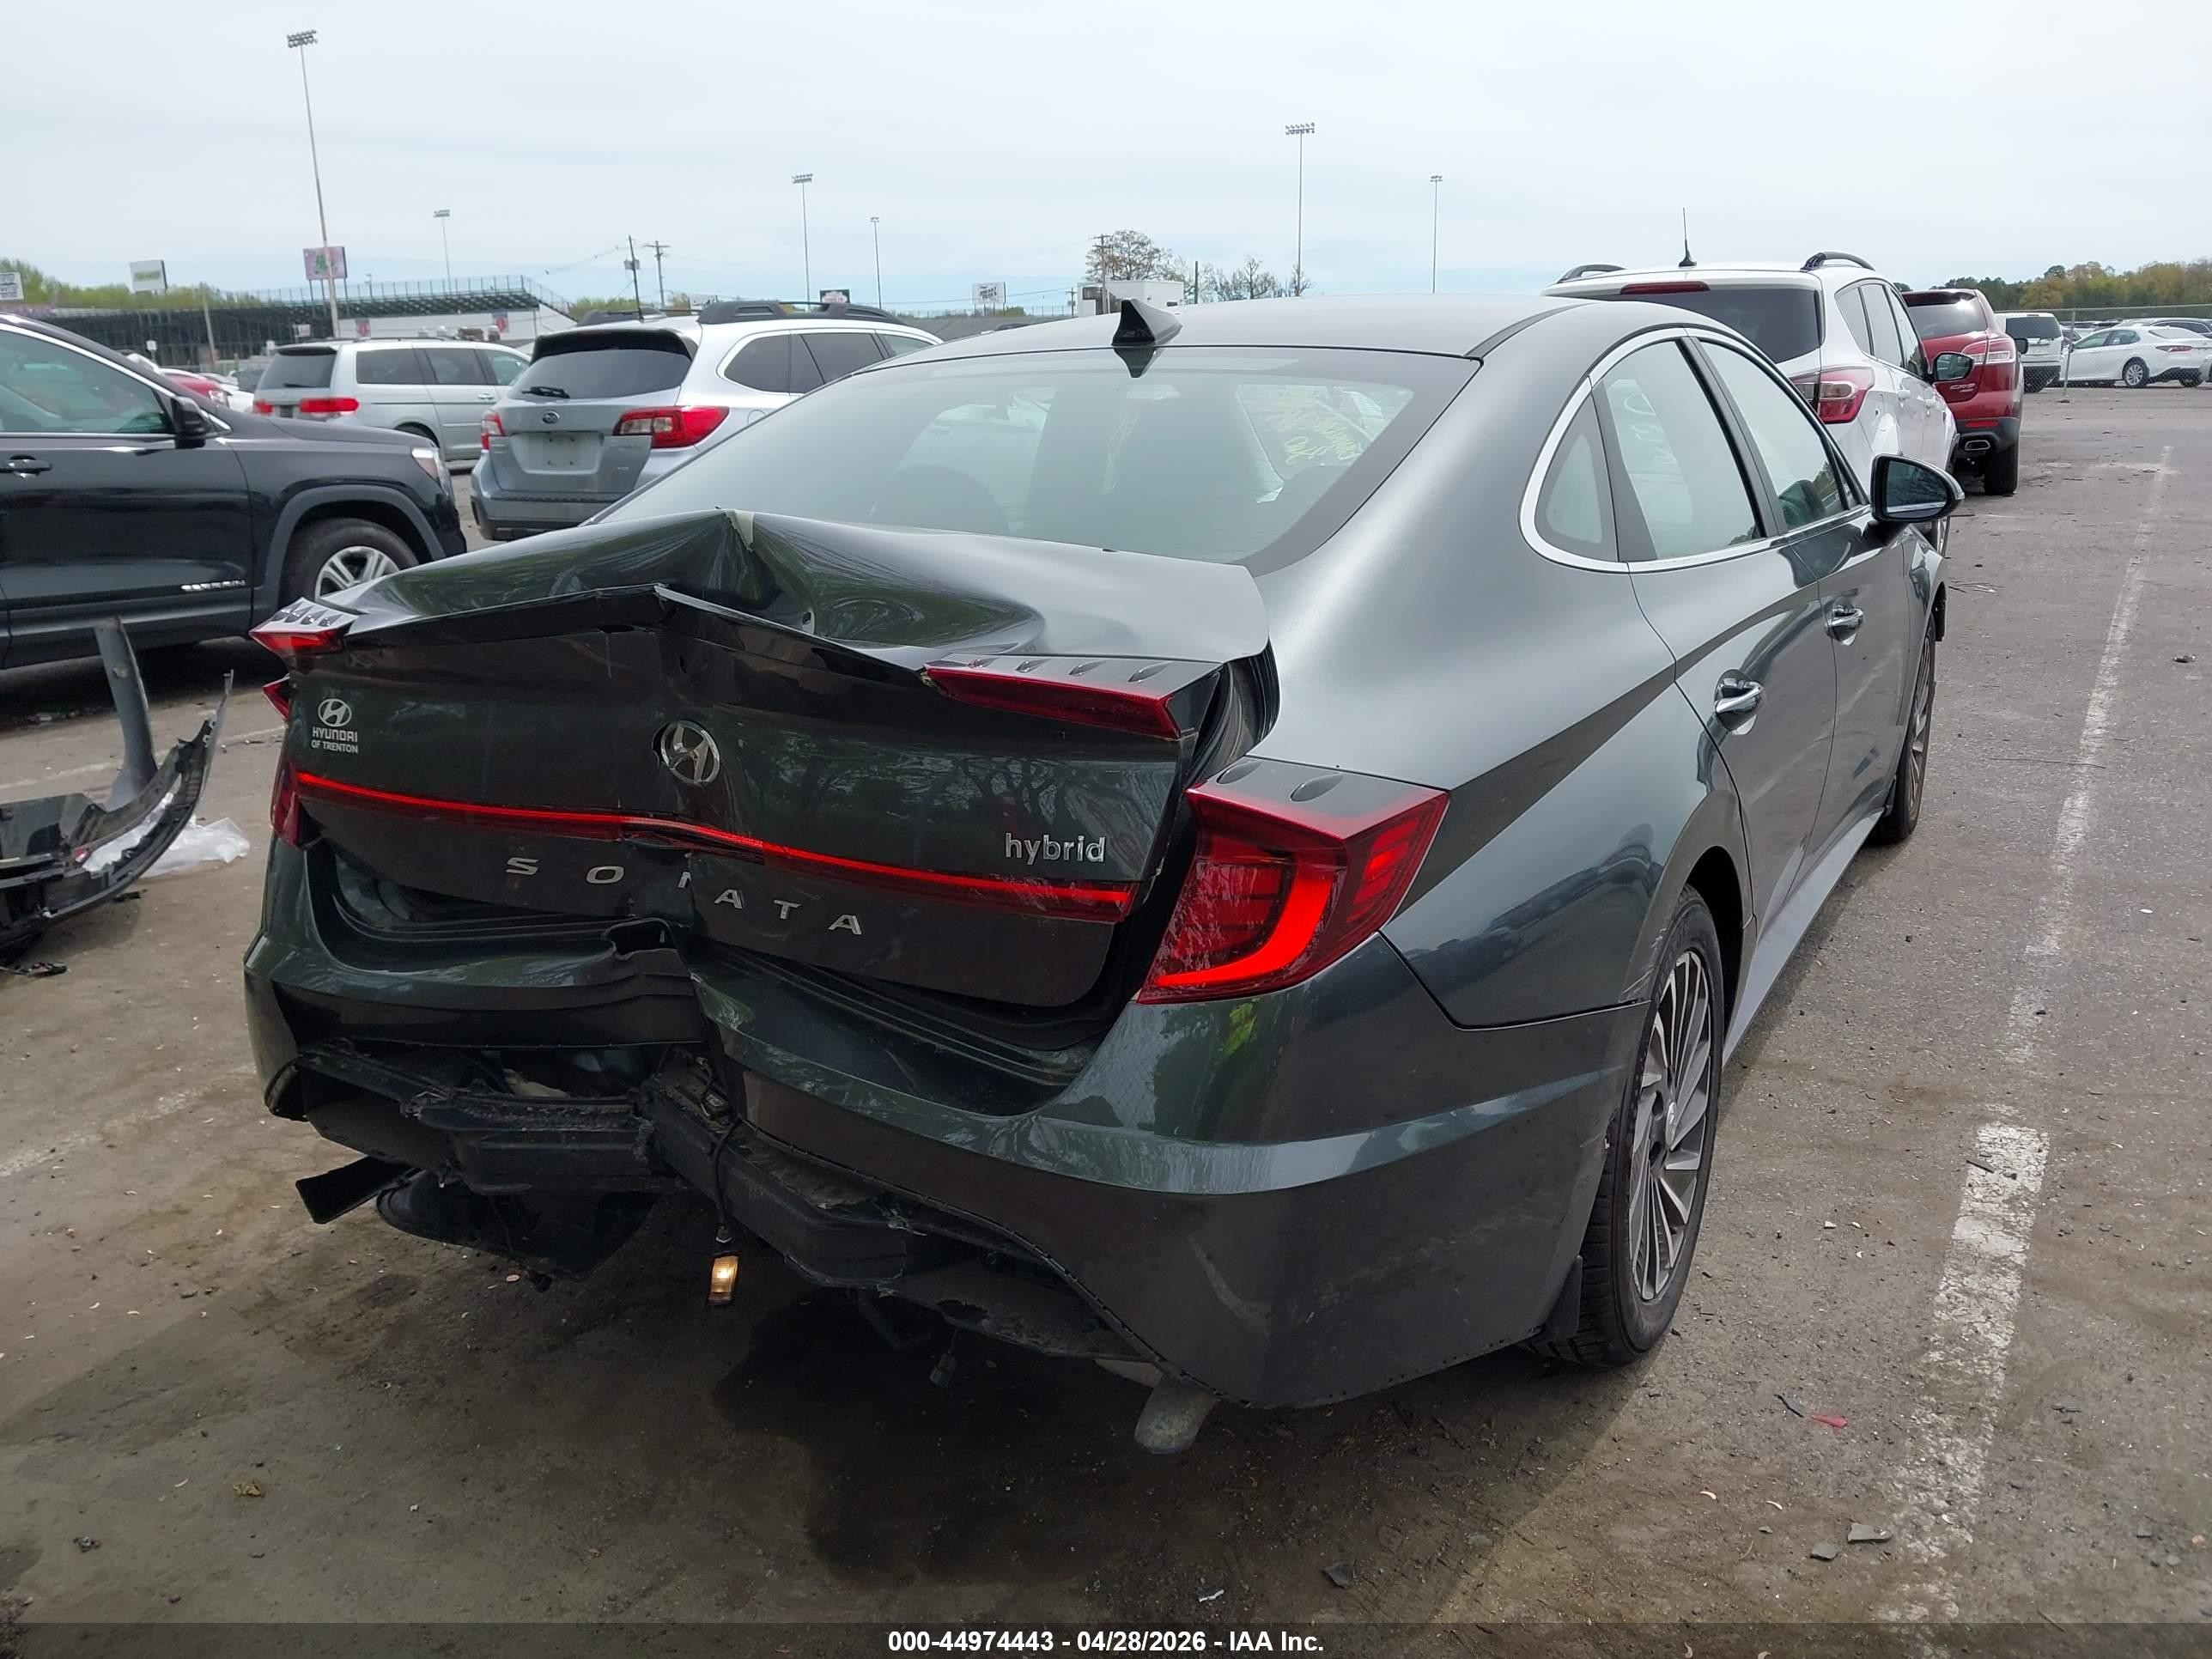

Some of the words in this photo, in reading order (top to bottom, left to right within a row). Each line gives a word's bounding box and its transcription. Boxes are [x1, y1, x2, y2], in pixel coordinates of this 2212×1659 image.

[312, 726, 358, 741] HYUNDAI
[311, 739, 321, 749] OF
[322, 741, 359, 754] TRENTON
[1006, 833, 1106, 866] hybrid
